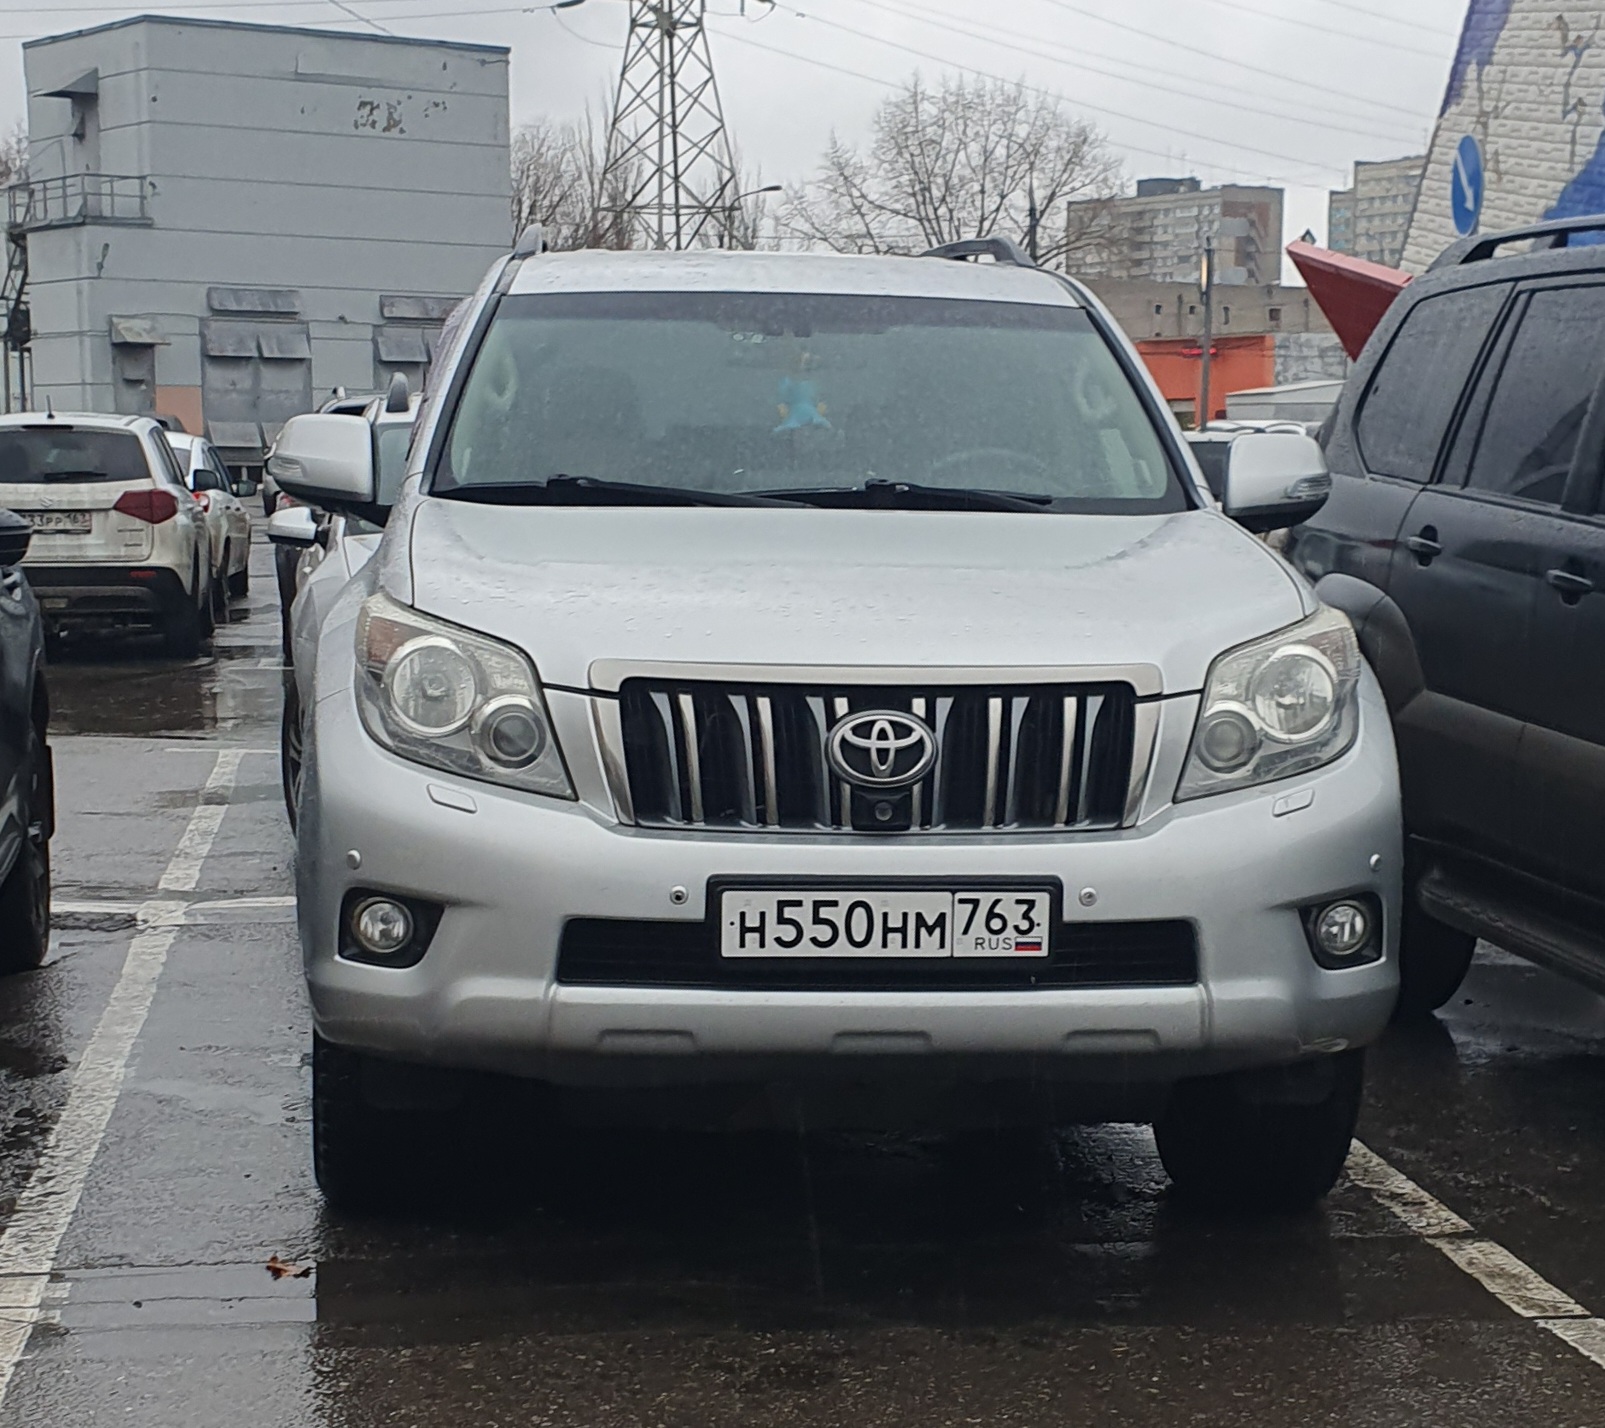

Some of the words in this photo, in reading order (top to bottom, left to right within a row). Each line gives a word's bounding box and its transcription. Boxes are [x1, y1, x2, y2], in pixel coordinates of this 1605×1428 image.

[20, 513, 63, 527] 33РР
[739, 899, 947, 949] Н550НМ
[957, 898, 1037, 936] 763
[974, 937, 1013, 951] RUS
